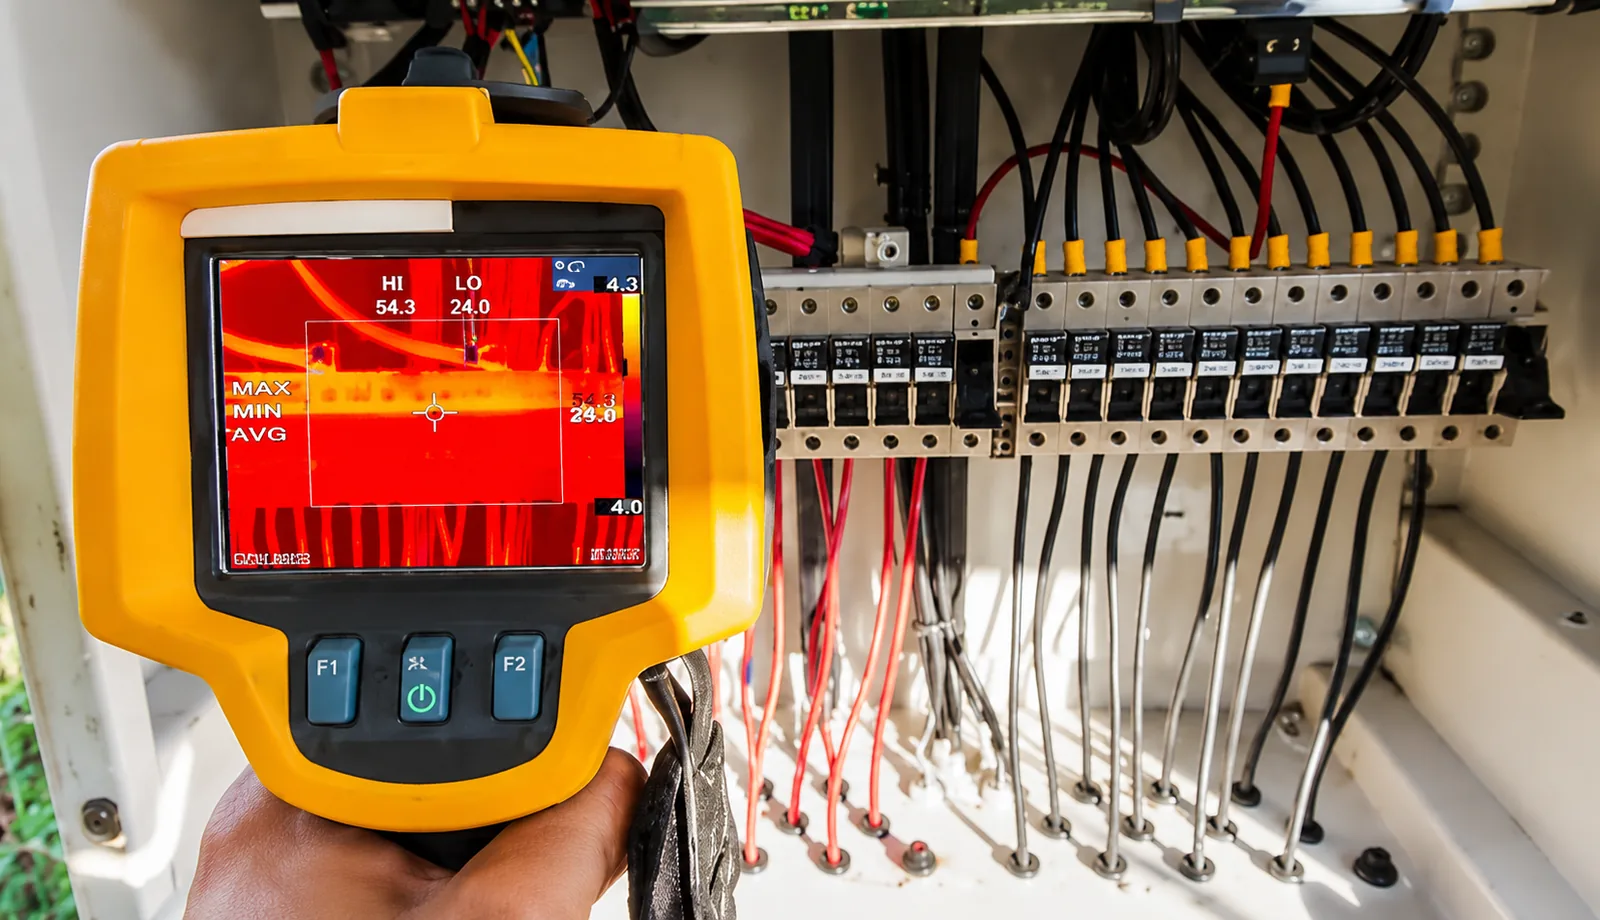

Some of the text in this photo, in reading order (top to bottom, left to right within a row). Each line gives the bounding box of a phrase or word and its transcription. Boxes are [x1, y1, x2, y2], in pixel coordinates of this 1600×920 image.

[382, 275, 404, 291] HI
[455, 275, 482, 291] LO
[606, 276, 638, 292] 4.3
[376, 299, 416, 315] 54.3
[450, 299, 490, 315] 24.0
[232, 381, 291, 396] MAX
[233, 403, 281, 419] MIN
[231, 427, 287, 442] AVG
[610, 499, 643, 515] 4.0
[317, 659, 337, 676] F1
[503, 656, 526, 672] F2
